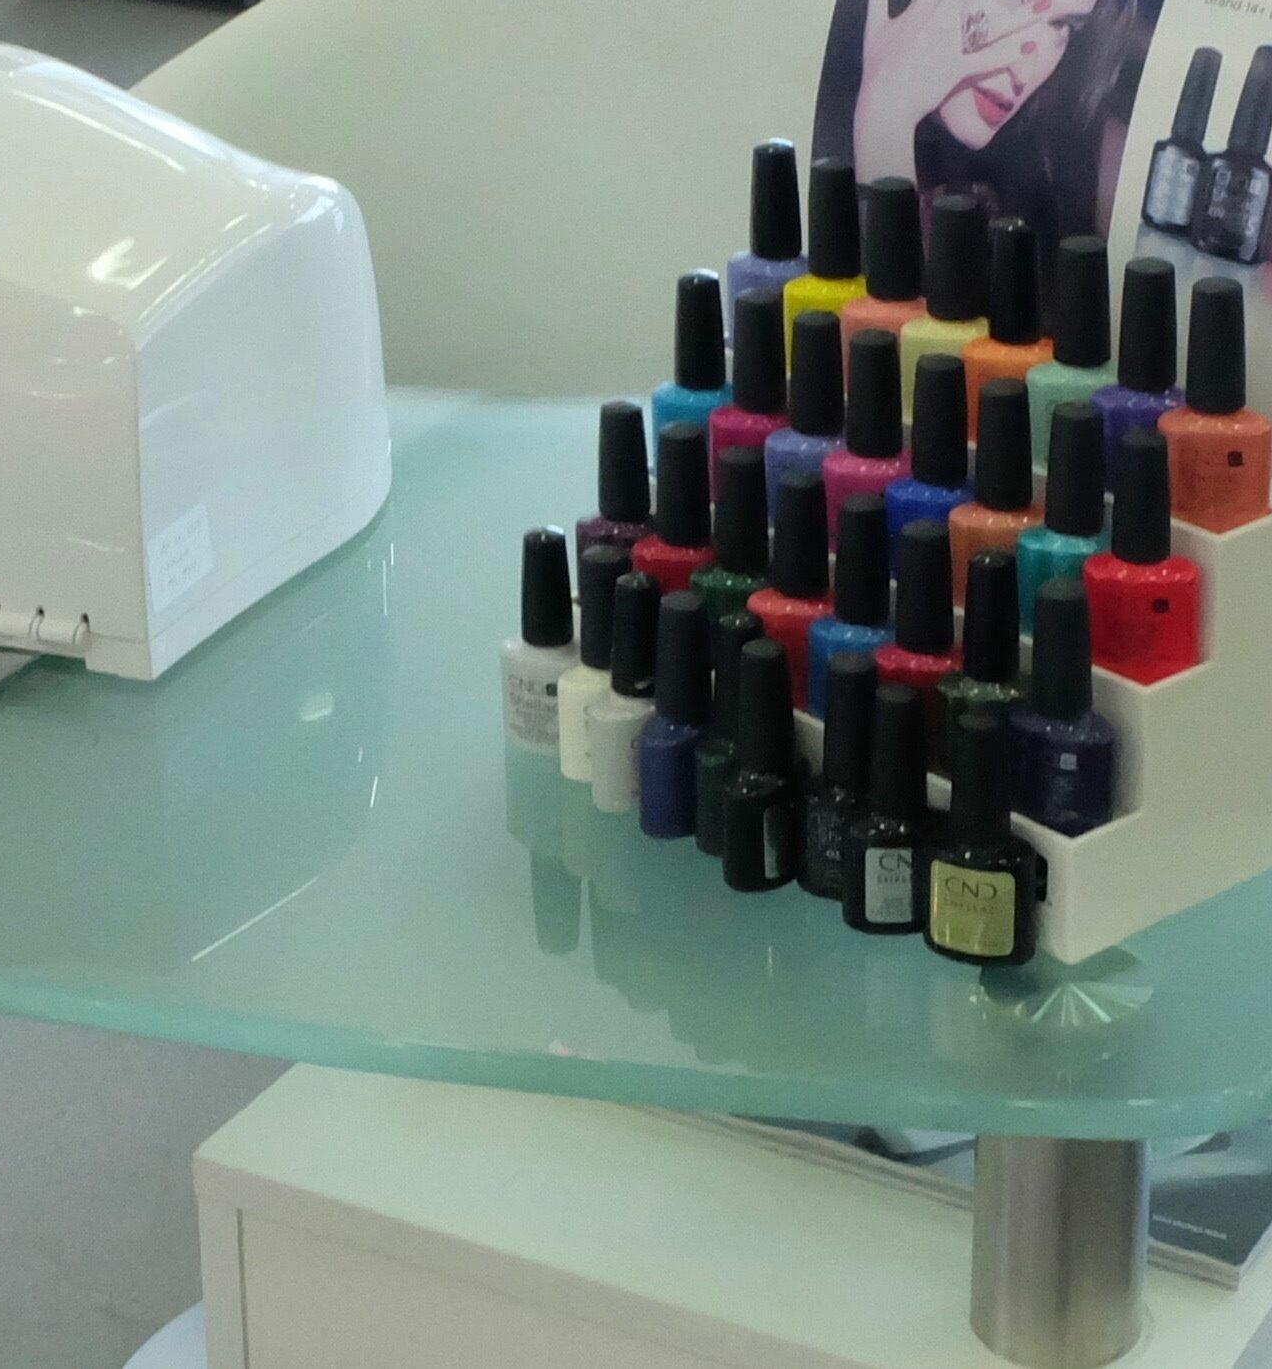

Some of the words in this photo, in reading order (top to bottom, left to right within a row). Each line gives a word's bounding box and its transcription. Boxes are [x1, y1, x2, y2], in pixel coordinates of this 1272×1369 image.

[1245, 1, 1266, 15] 14+
[879, 852, 912, 872] CN
[944, 876, 998, 901] CND
